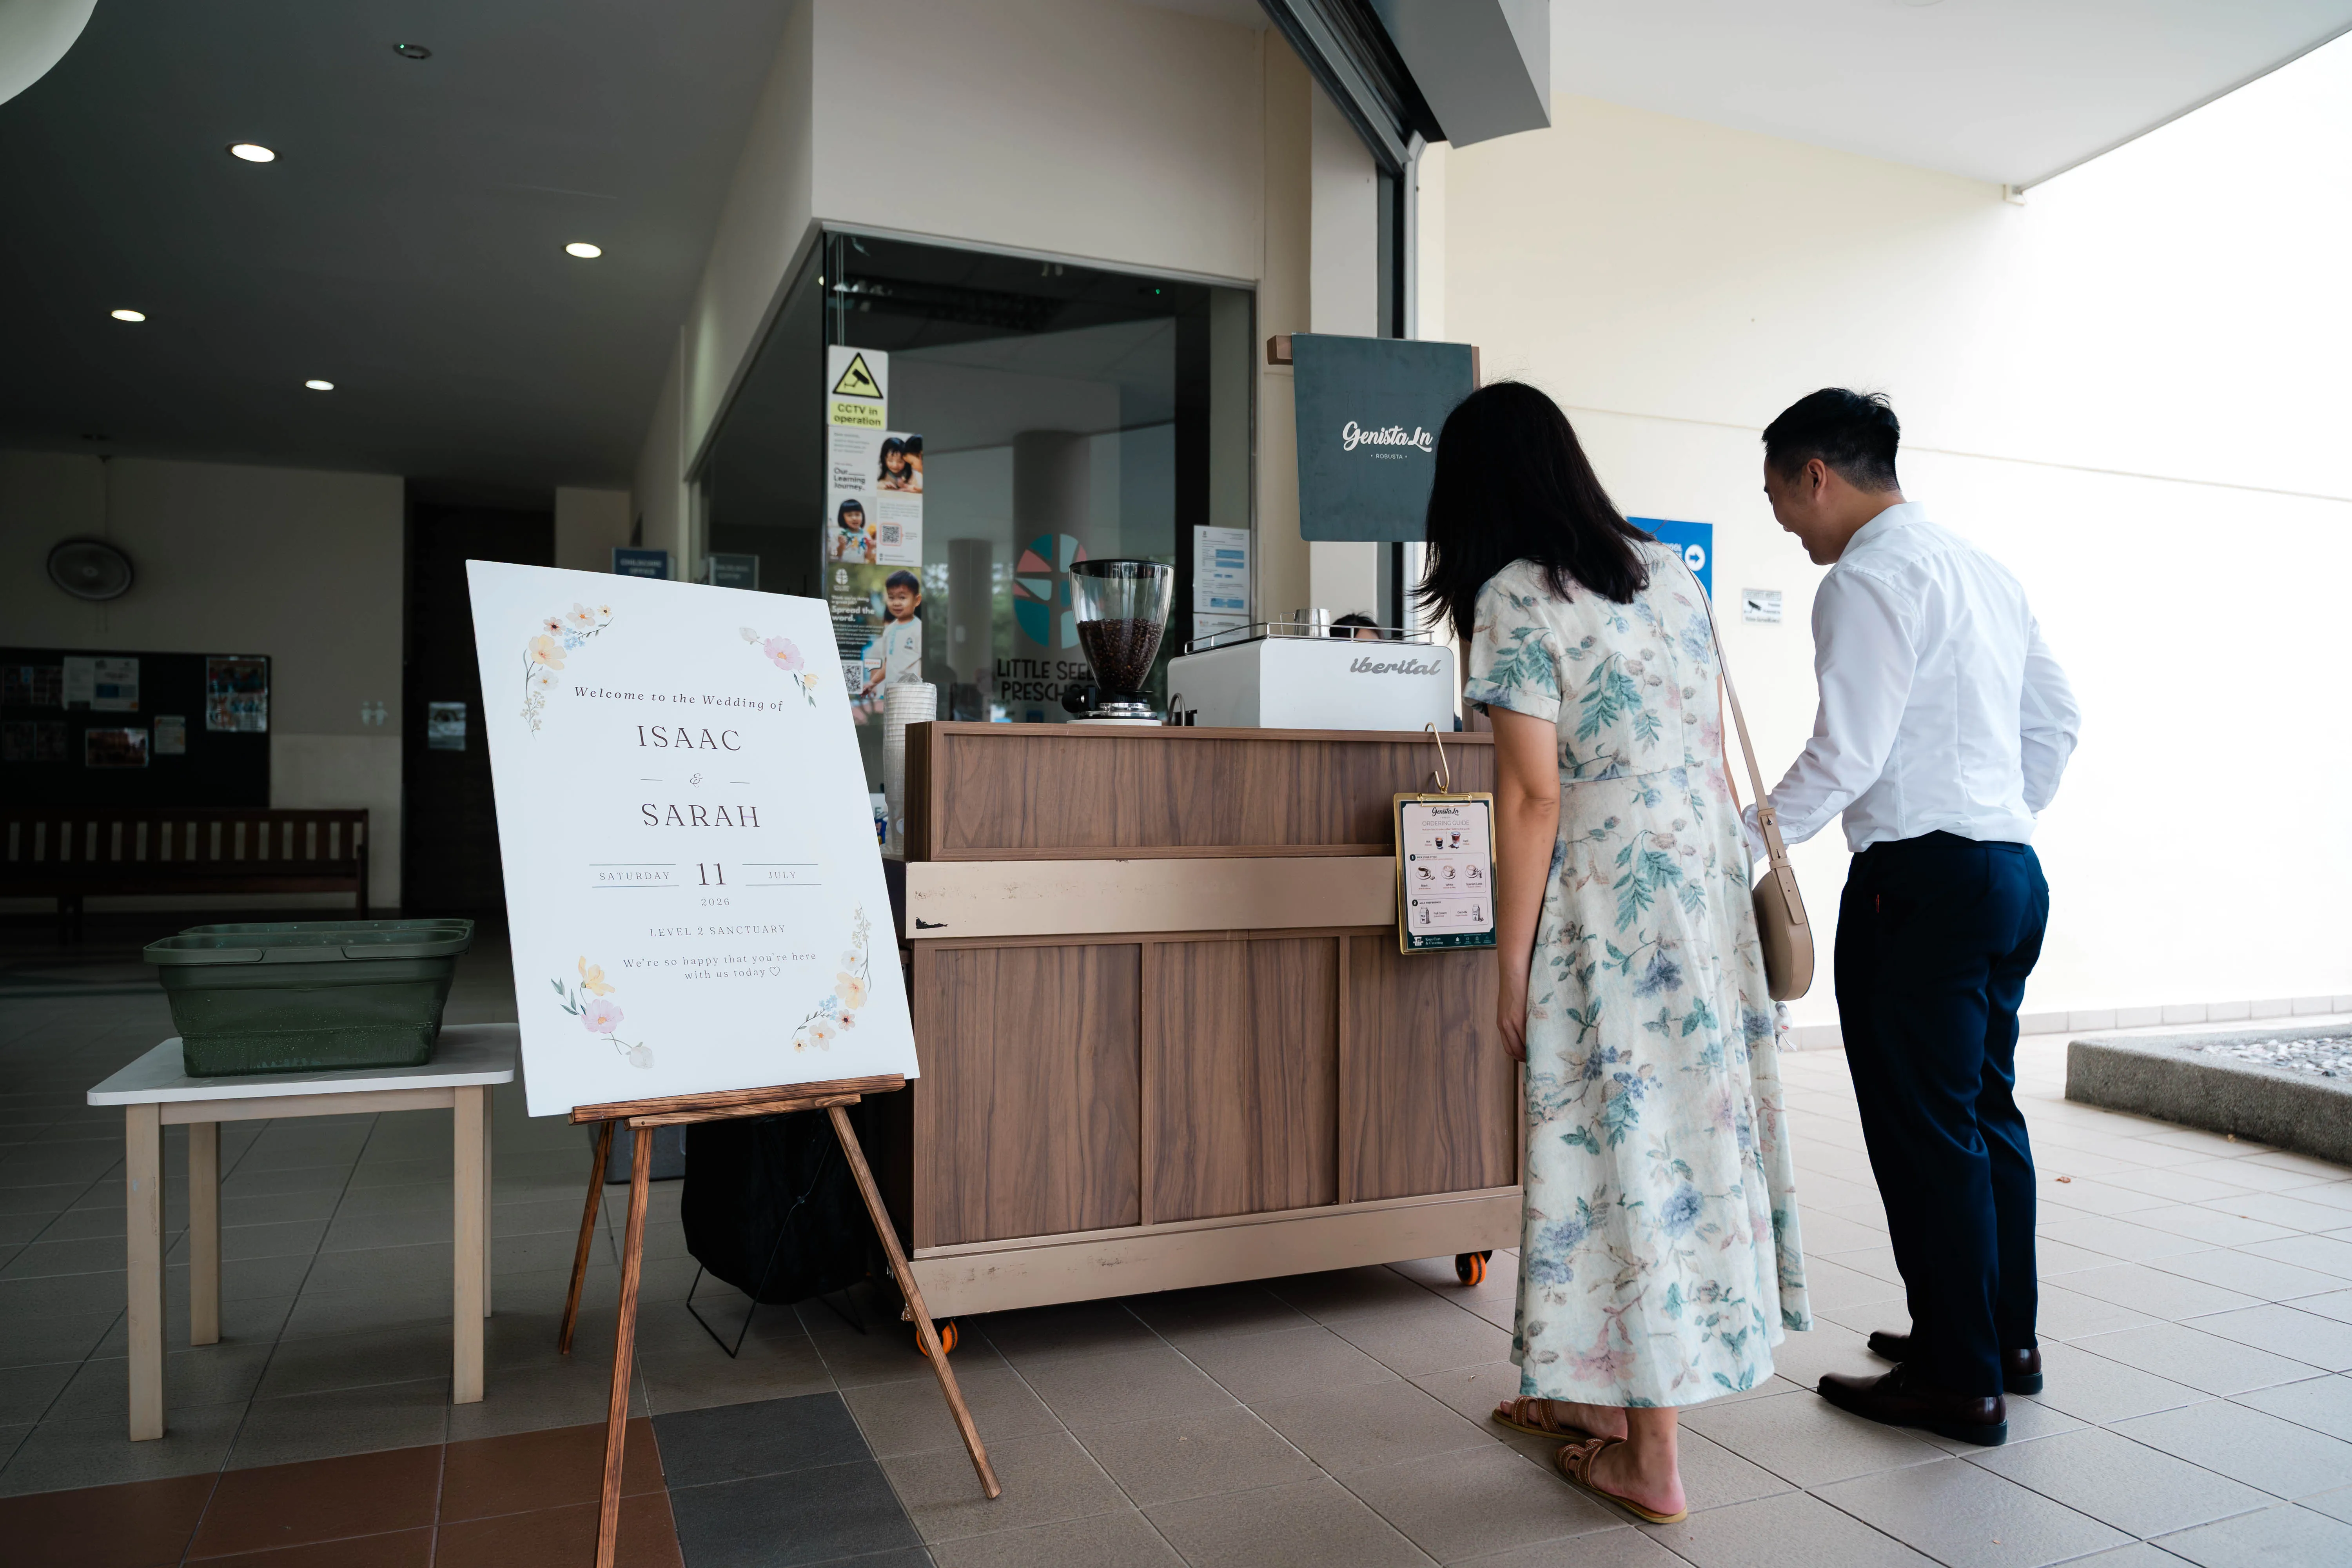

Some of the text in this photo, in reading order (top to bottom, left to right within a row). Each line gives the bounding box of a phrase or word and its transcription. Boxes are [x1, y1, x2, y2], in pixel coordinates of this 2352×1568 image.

[838, 403, 878, 415] CCTV in
[834, 415, 881, 426] operation
[1342, 421, 1408, 452] Genista
[834, 475, 866, 485] Learning
[831, 605, 860, 615] Spread
[998, 659, 1051, 679] LITTLE
[1350, 657, 1441, 675] iberital
[574, 687, 644, 700] Welcome
[673, 693, 695, 703] the
[702, 695, 764, 711] Wedding
[770, 701, 783, 711] of
[636, 725, 741, 751] ISAAC
[690, 773, 703, 788] &
[642, 804, 760, 827] SARAH
[1432, 807, 1451, 817] Genista
[599, 871, 670, 880] SATURDAY
[696, 863, 727, 885] 11
[701, 898, 730, 906] 2026
[650, 924, 785, 937] LEVEL 2 SANCTUARY
[682, 956, 719, 967] happy
[724, 955, 748, 963] that
[792, 952, 817, 961] here
[684, 969, 711, 979] with
[734, 967, 766, 978] today
